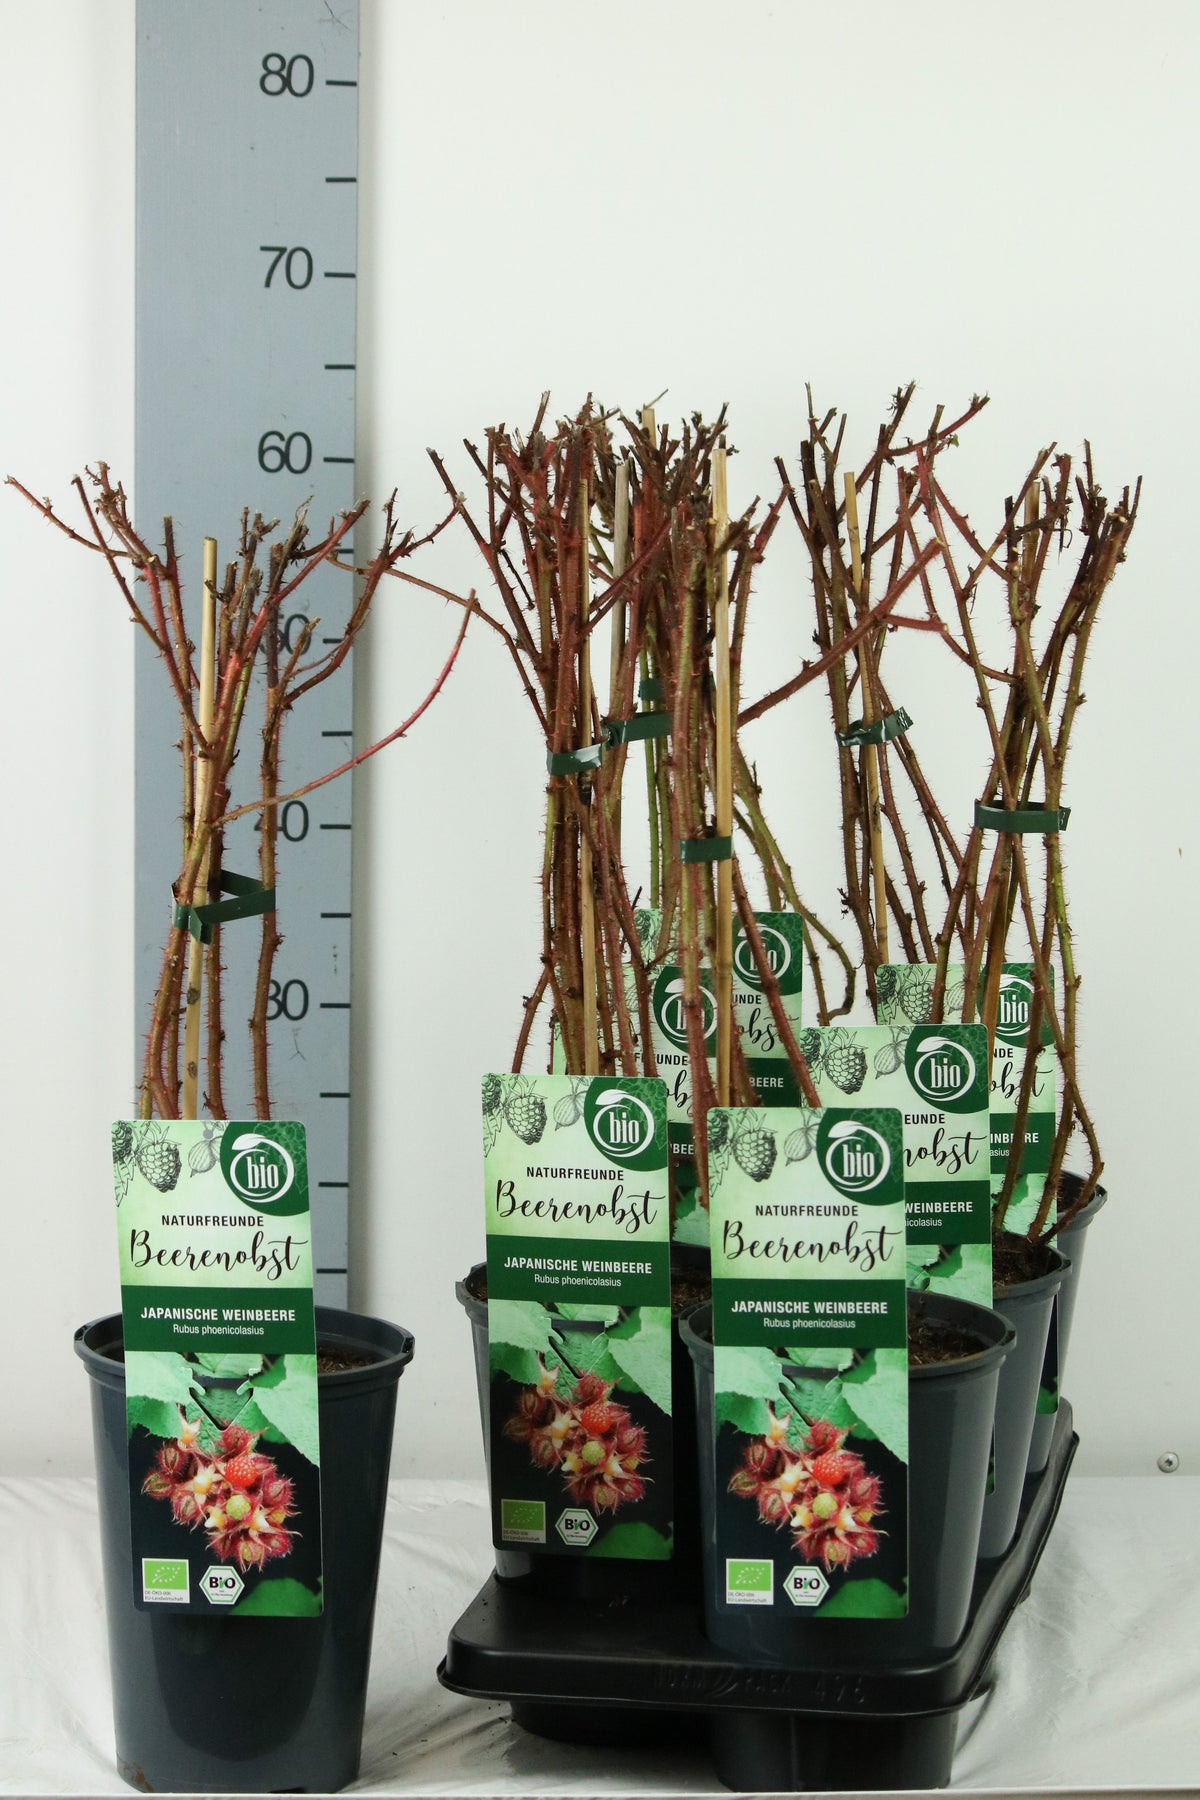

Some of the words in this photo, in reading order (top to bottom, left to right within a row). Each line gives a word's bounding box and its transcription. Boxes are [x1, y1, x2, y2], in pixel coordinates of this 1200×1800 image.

[259, 53, 314, 97] 80
[260, 246, 314, 289] 70
[258, 430, 312, 474] 60
[930, 1057, 961, 1089] bio
[609, 1111, 640, 1144] bio
[247, 1156, 279, 1189] bio
[526, 1166, 624, 1181] NATURFREUNDE
[842, 1144, 875, 1177] bio
[161, 1215, 264, 1227] NATURFREUNDE
[496, 1179, 666, 1234] Beerenobst
[755, 1205, 859, 1217] NATURFREUNDE
[130, 1229, 309, 1281] Beerenobst
[723, 1220, 903, 1272] Beerenobst
[504, 1257, 578, 1271] JAPANISCHE
[582, 1260, 652, 1274] WEINBEERE
[534, 1274, 560, 1285] Rubus
[561, 1275, 622, 1287] phoenicolasius
[141, 1307, 218, 1321] JAPANISCHE
[222, 1309, 296, 1321] WEINBEERE
[731, 1301, 810, 1313] JAPANISCHE
[814, 1302, 888, 1314] WEINBEERE
[763, 1318, 790, 1328] Rubus
[792, 1318, 856, 1329] phoenicolasius
[173, 1324, 200, 1335] Rubus
[202, 1324, 264, 1336] phoenicolasius
